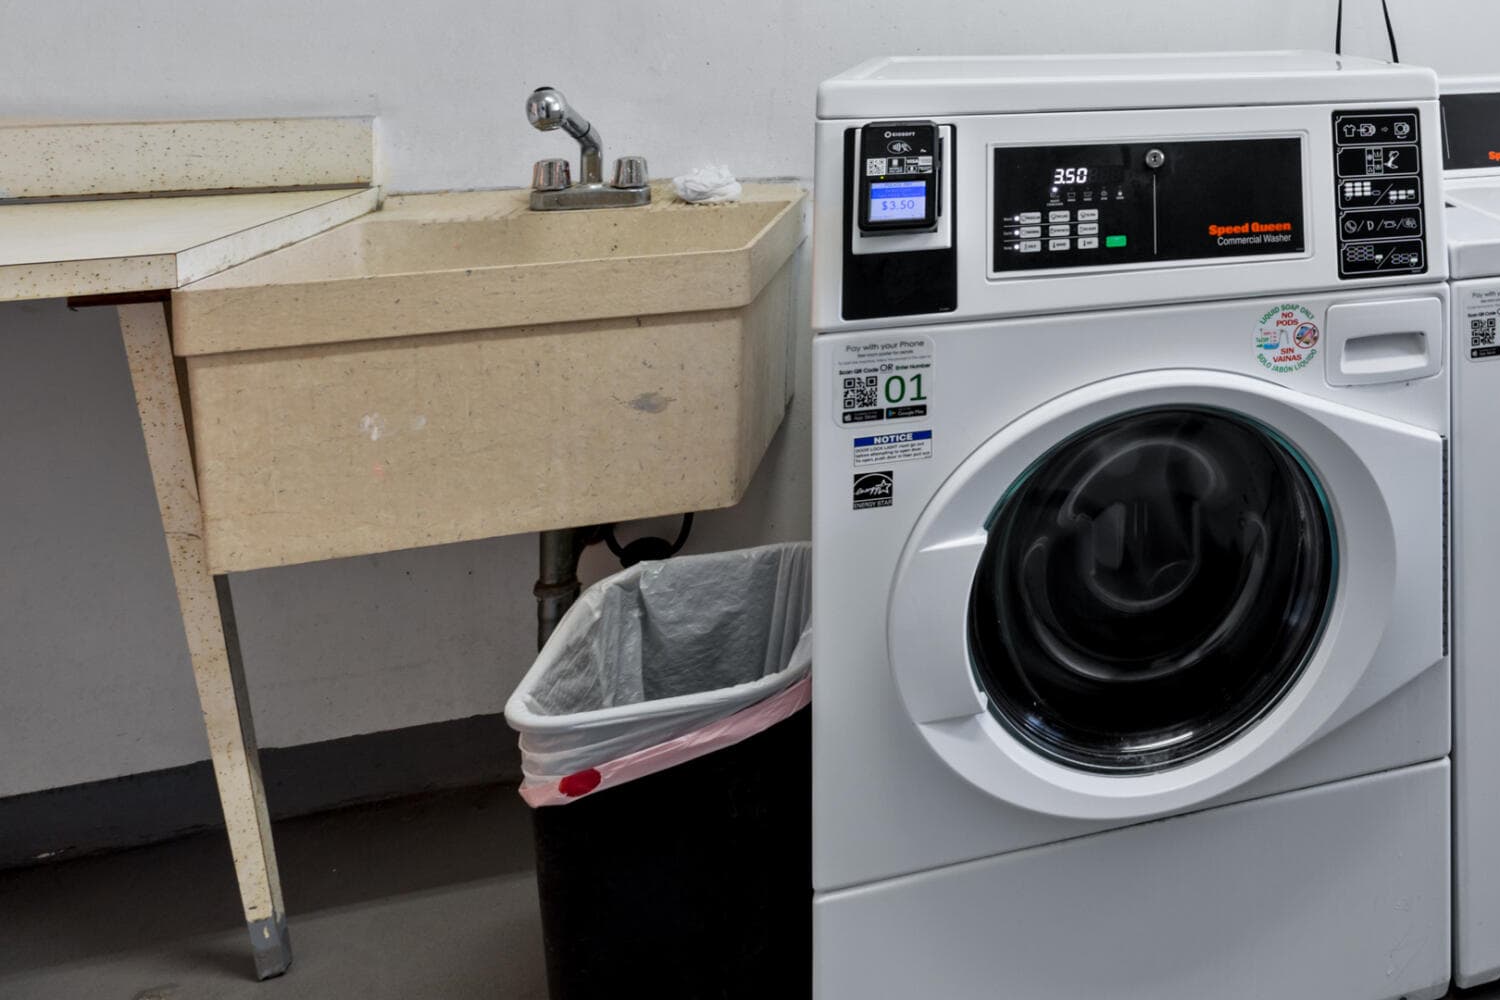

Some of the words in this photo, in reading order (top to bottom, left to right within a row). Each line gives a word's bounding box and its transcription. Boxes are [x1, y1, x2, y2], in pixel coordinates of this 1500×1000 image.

[1053, 167, 1089, 185] 3.50
[1208, 222, 1249, 237] Speed
[1251, 221, 1292, 233] Queen
[1217, 235, 1262, 246] Commercial
[1263, 234, 1292, 243] Washer
[1260, 306, 1280, 325] LIQUID
[1300, 306, 1315, 320] ONLY
[1281, 311, 1294, 319] NO
[1276, 319, 1300, 327] PODS
[846, 345, 861, 353] Pay
[900, 340, 925, 348] Phone
[1280, 347, 1295, 355] SIN
[1257, 353, 1272, 368] SOLO
[1272, 353, 1303, 363] VAINAS
[880, 363, 894, 372] OR
[885, 373, 928, 404] 01
[873, 431, 914, 445] NOTICE
